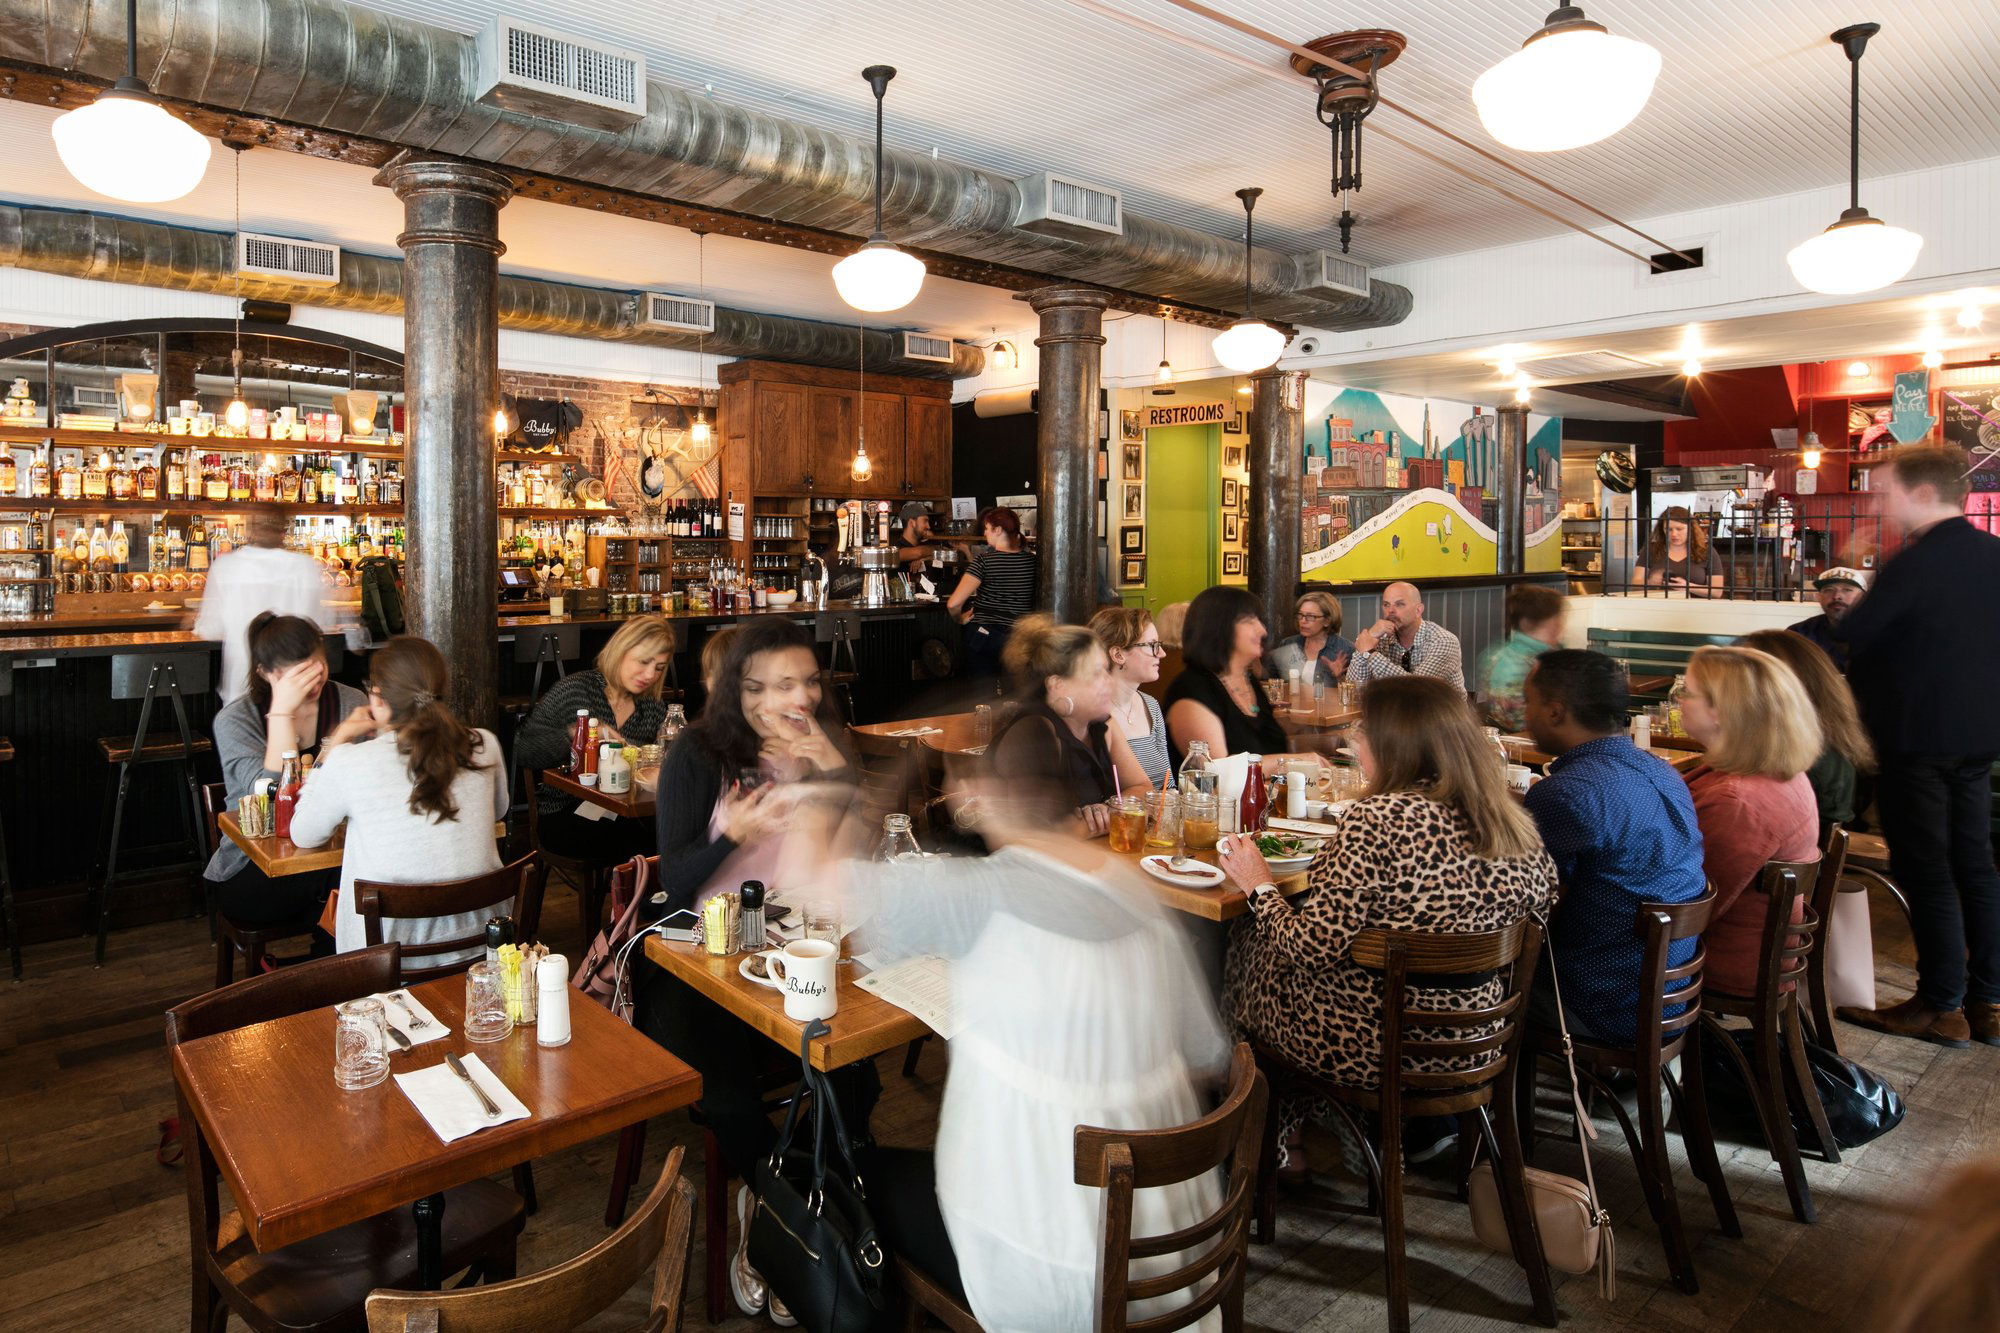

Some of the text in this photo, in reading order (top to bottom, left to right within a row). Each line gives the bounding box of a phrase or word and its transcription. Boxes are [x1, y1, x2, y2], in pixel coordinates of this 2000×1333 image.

[1895, 384, 1926, 404] Pay
[1150, 404, 1224, 425] RESTROOMS
[786, 976, 827, 996] Bubby's
